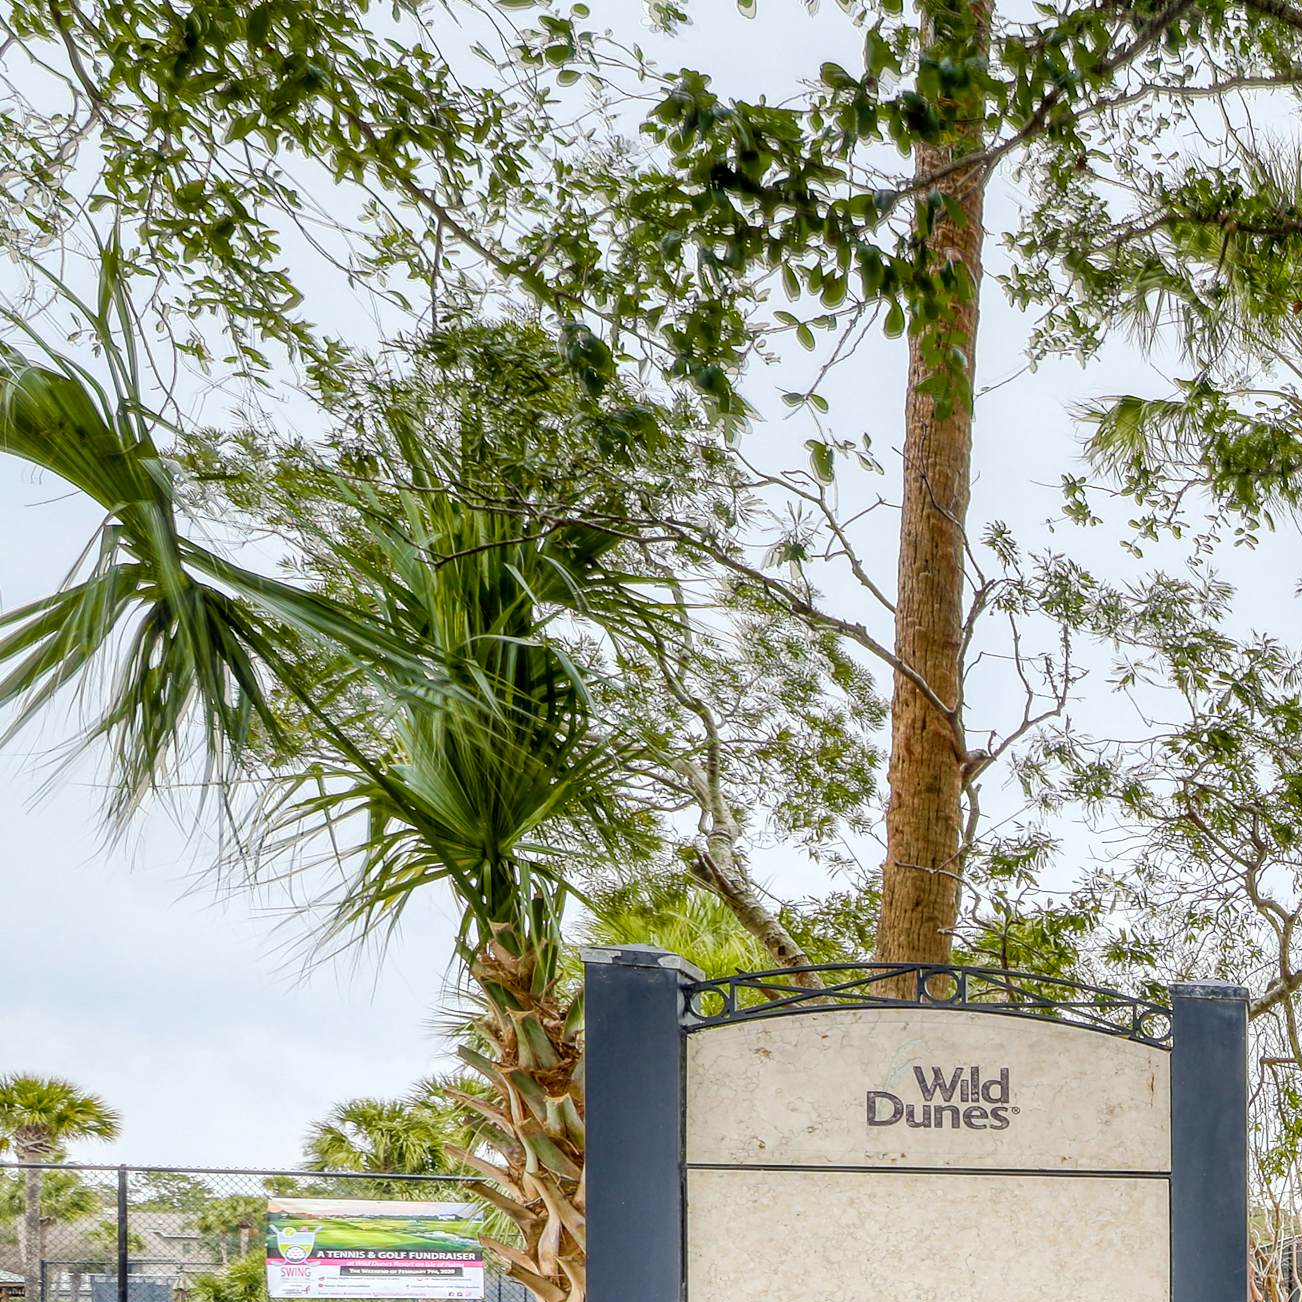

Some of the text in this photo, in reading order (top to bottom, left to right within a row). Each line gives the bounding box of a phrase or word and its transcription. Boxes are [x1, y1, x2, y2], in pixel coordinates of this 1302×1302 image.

[913, 1066, 1010, 1104] Wild
[327, 1251, 366, 1259] TENNIS
[367, 1251, 377, 1259] &
[377, 1251, 407, 1260] GOLF
[409, 1252, 476, 1261] FUNDRAISER
[280, 1267, 311, 1277] SWING
